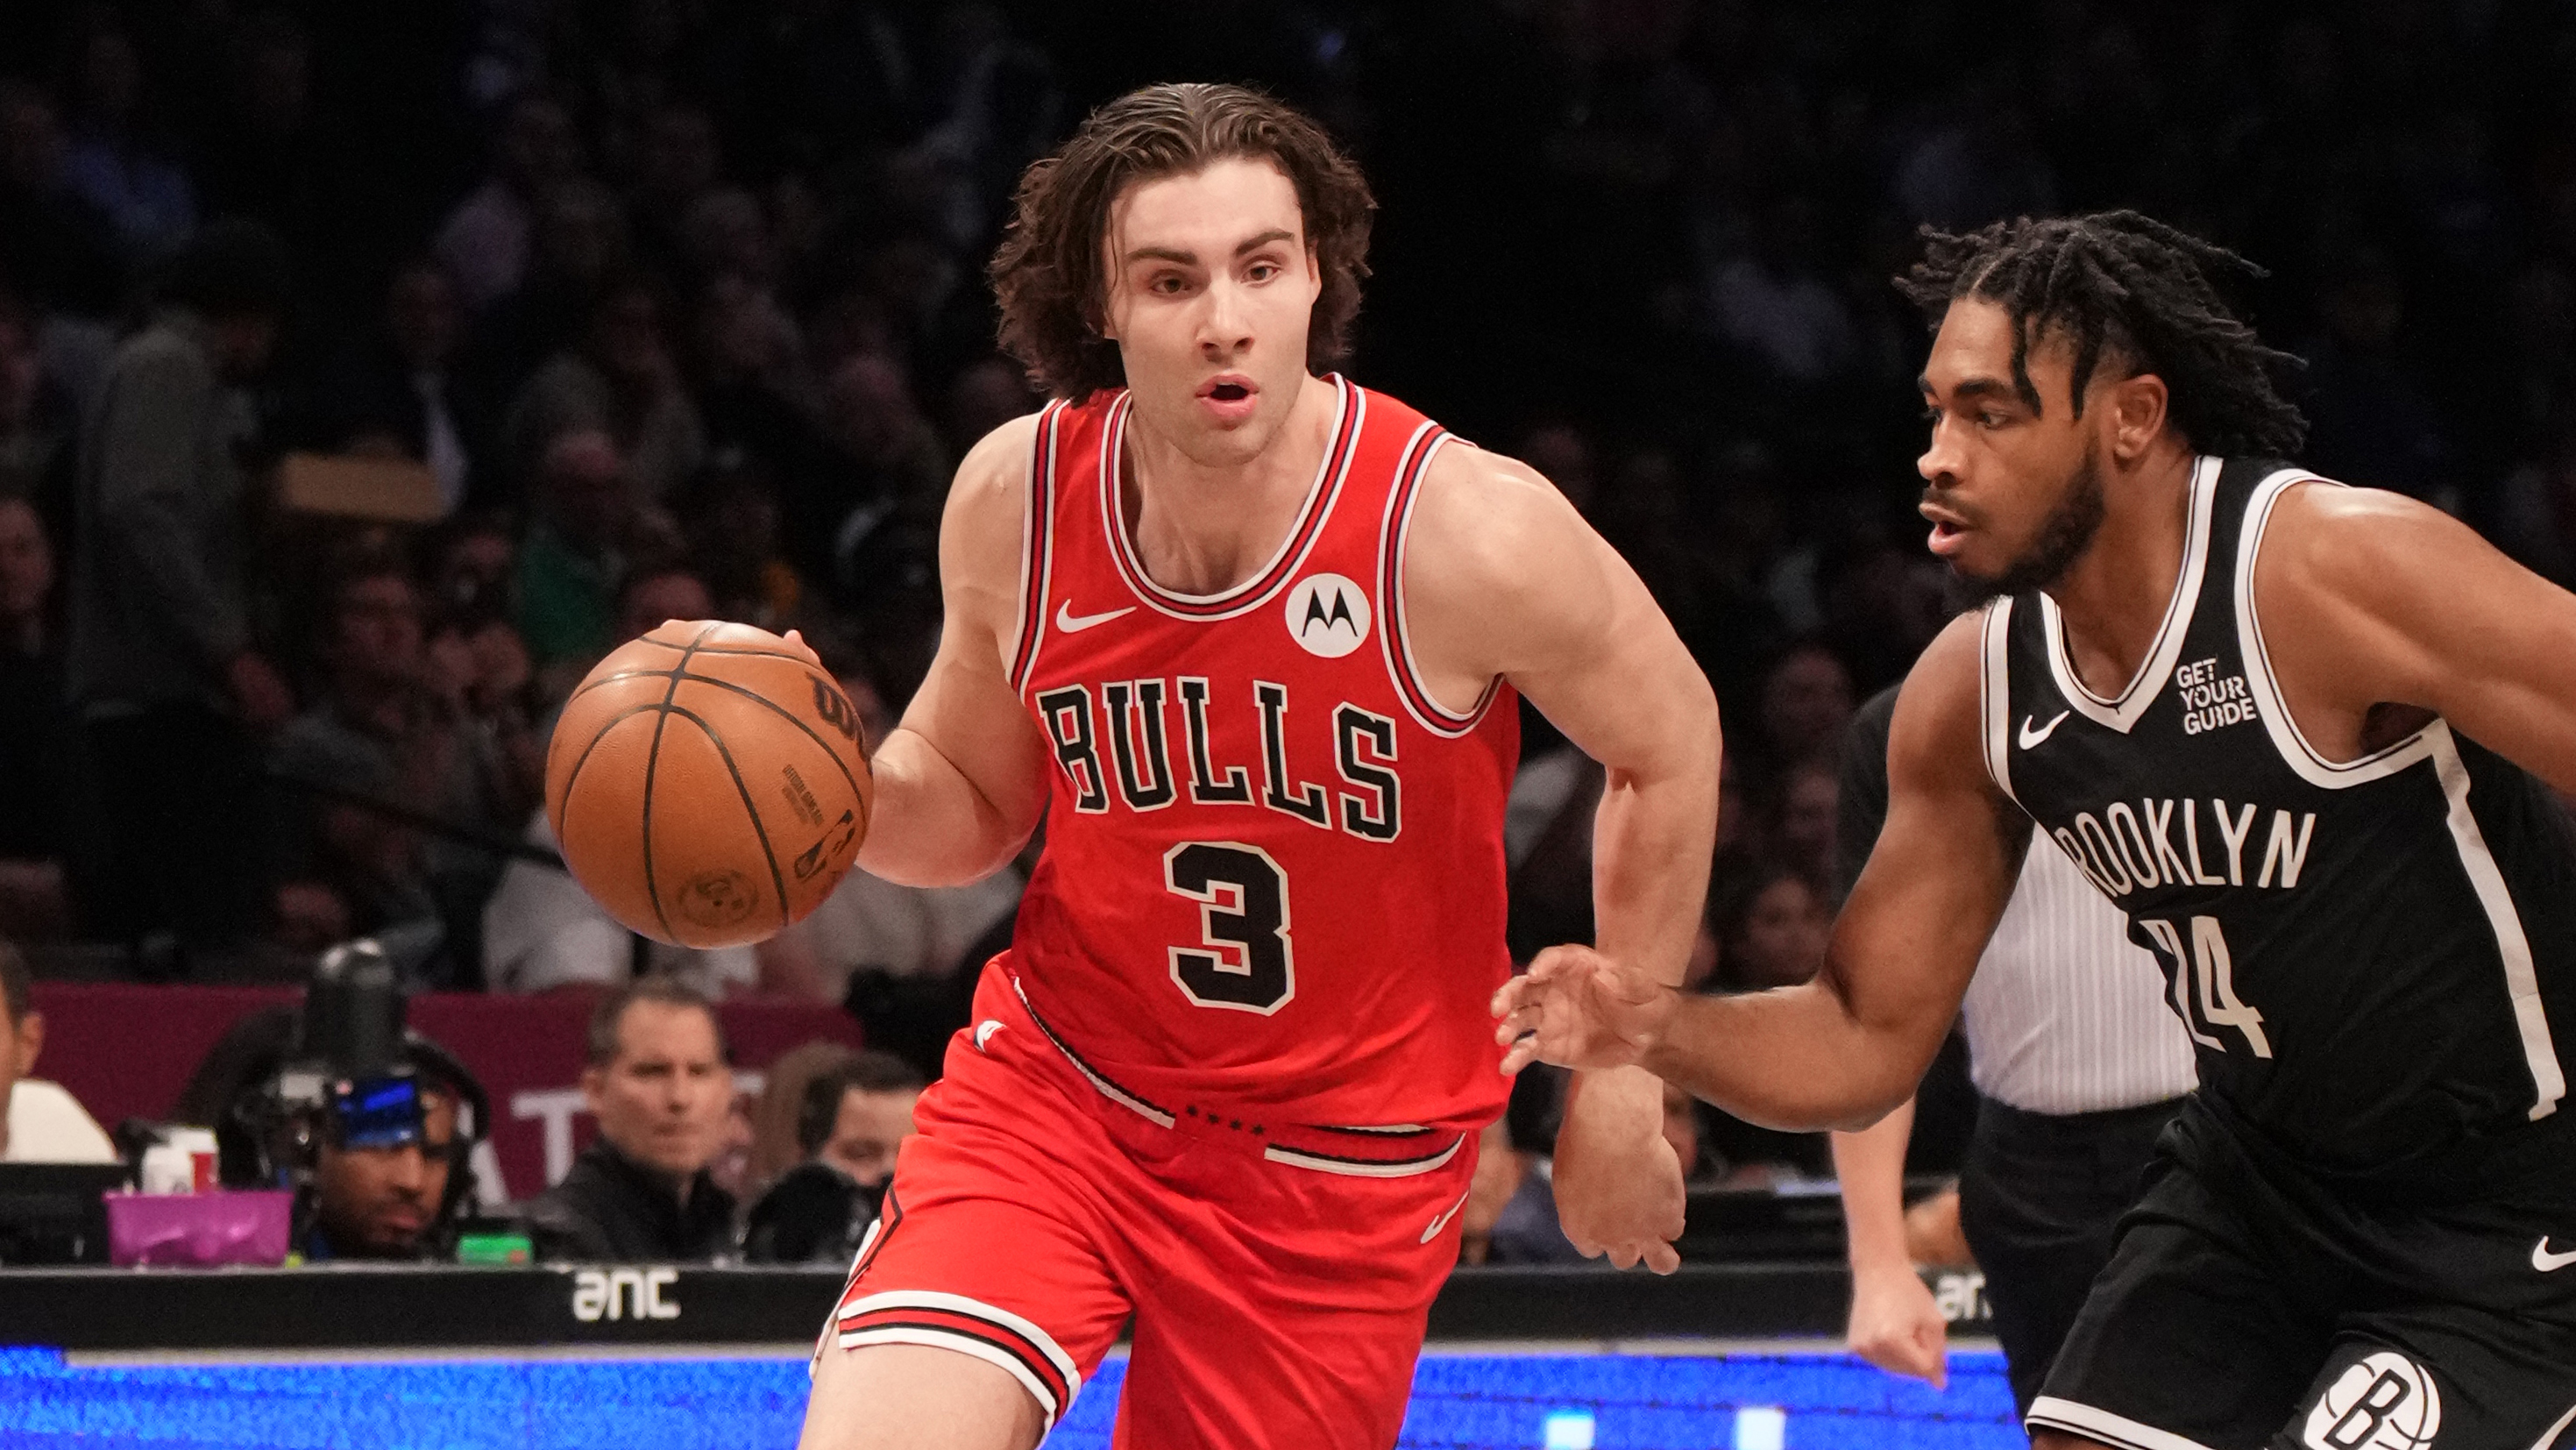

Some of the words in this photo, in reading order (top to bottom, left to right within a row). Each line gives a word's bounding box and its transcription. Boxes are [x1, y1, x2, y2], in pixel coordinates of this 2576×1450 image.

[2176, 657, 2216, 688] GET
[2180, 676, 2246, 711] YOUR
[2184, 697, 2256, 736] GUIDE
[1036, 676, 1402, 843] BULLS
[2054, 798, 2317, 898] ROOKLYN
[1163, 841, 1295, 1016] 3
[573, 1271, 682, 1320] anc
[1935, 1274, 1994, 1321] an
